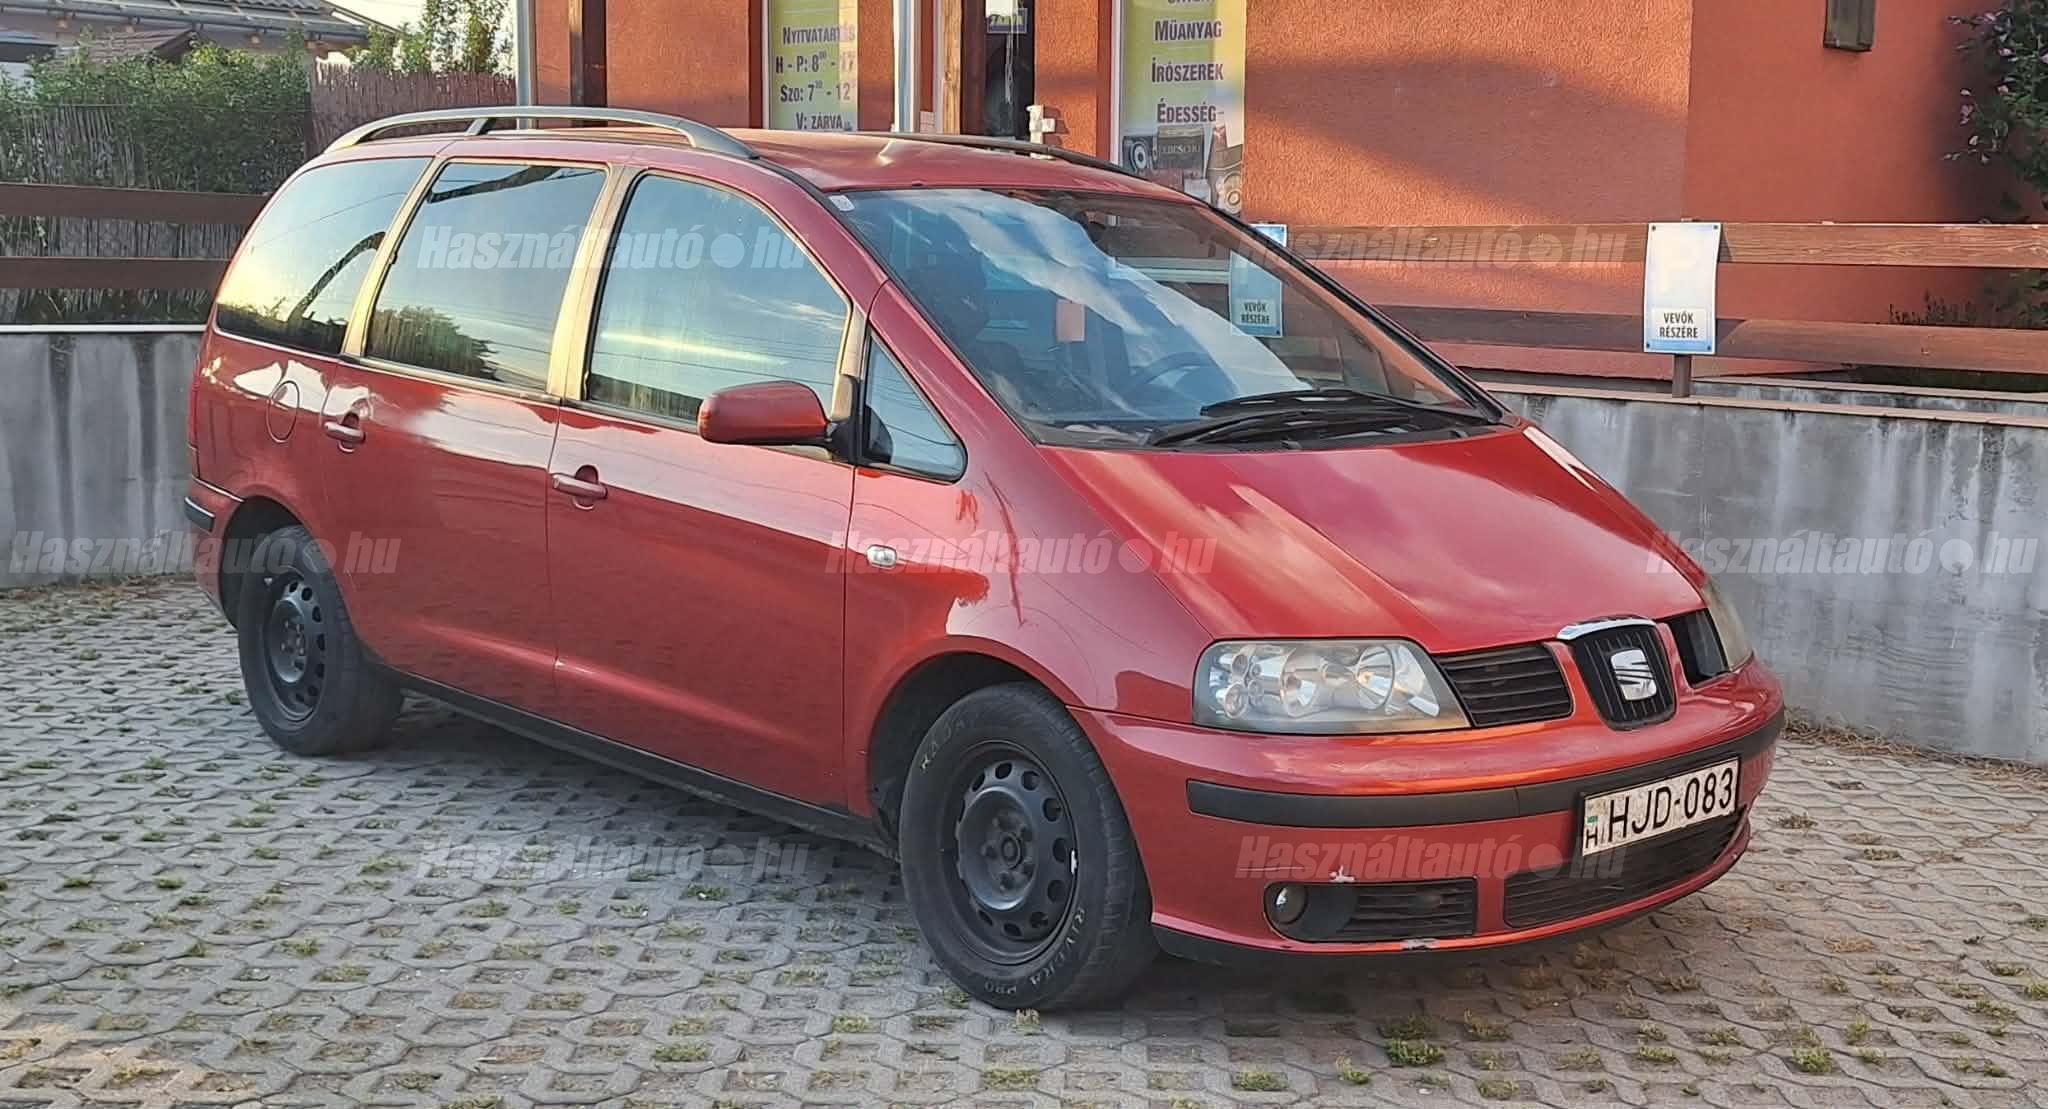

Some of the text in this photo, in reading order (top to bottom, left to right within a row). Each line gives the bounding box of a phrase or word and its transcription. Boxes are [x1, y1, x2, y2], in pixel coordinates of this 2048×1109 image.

[775, 56, 784, 73] H
[1157, 98, 1217, 124] ÉDESSÉG
[1659, 325, 1699, 339] RÉSZÉRE
[1608, 767, 1733, 843] HJD-083
